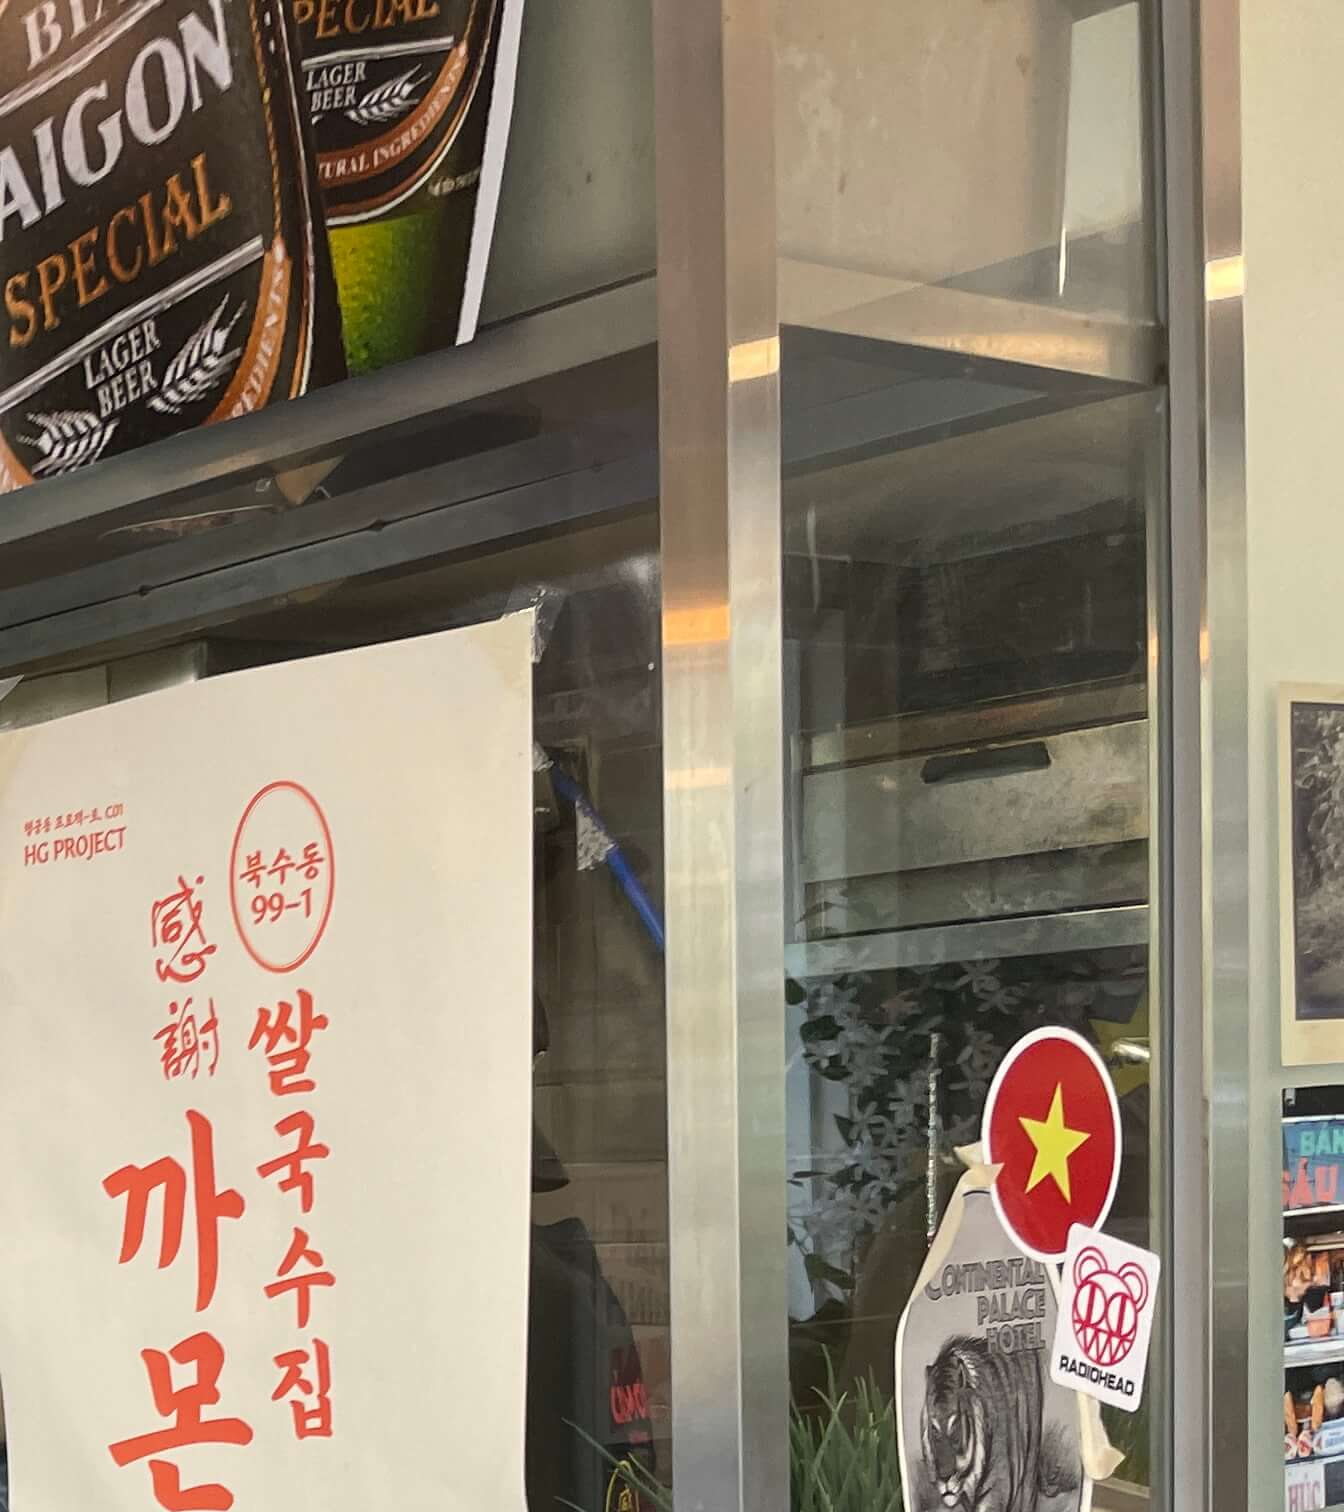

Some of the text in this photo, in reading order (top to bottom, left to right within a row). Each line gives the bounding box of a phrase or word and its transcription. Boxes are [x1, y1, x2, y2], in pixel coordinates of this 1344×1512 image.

[306, 63, 366, 92] LAGER
[311, 87, 357, 112] BEER
[3, 154, 230, 347] SPECIAL
[83, 317, 160, 390] LAGER
[96, 360, 159, 419] BEER
[23, 826, 127, 867] HG PROJECT
[238, 840, 325, 888] 북수동
[249, 888, 313, 927] 99-1
[247, 988, 337, 1440] 쌀국수집
[924, 1257, 1046, 1302] CONTINENTAL
[101, 1108, 254, 1512] 까몬
[976, 1288, 1046, 1326] PALACE
[985, 1321, 1047, 1355] HOTEL
[1059, 1354, 1136, 1397] RADIOHEAD
